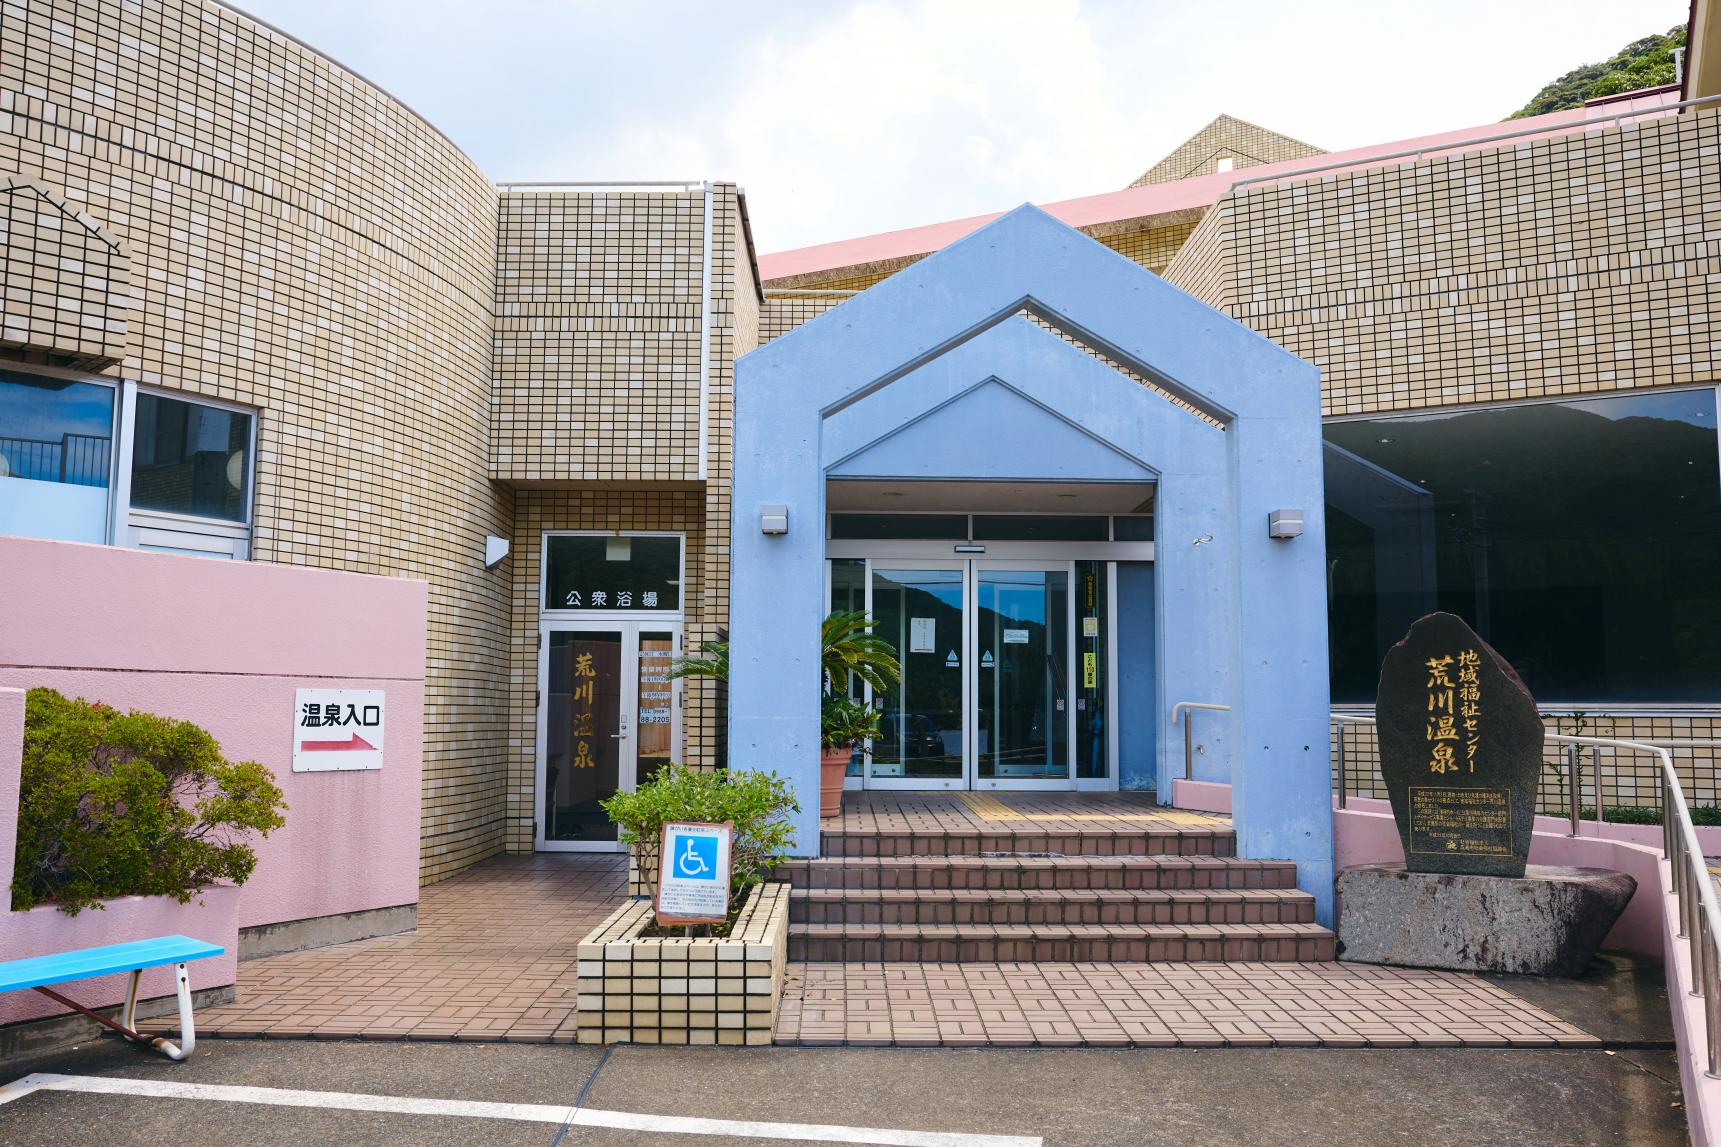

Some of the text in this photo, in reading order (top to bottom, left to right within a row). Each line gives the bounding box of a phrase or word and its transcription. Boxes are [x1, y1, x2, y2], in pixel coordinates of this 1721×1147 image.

[566, 591, 658, 607] 公衆浴場
[301, 703, 380, 727] 温泉入口
[574, 652, 596, 769] 荒川温泉
[1425, 655, 1460, 774] 荒川温泉
[1458, 649, 1481, 773] 地域福祉センター
